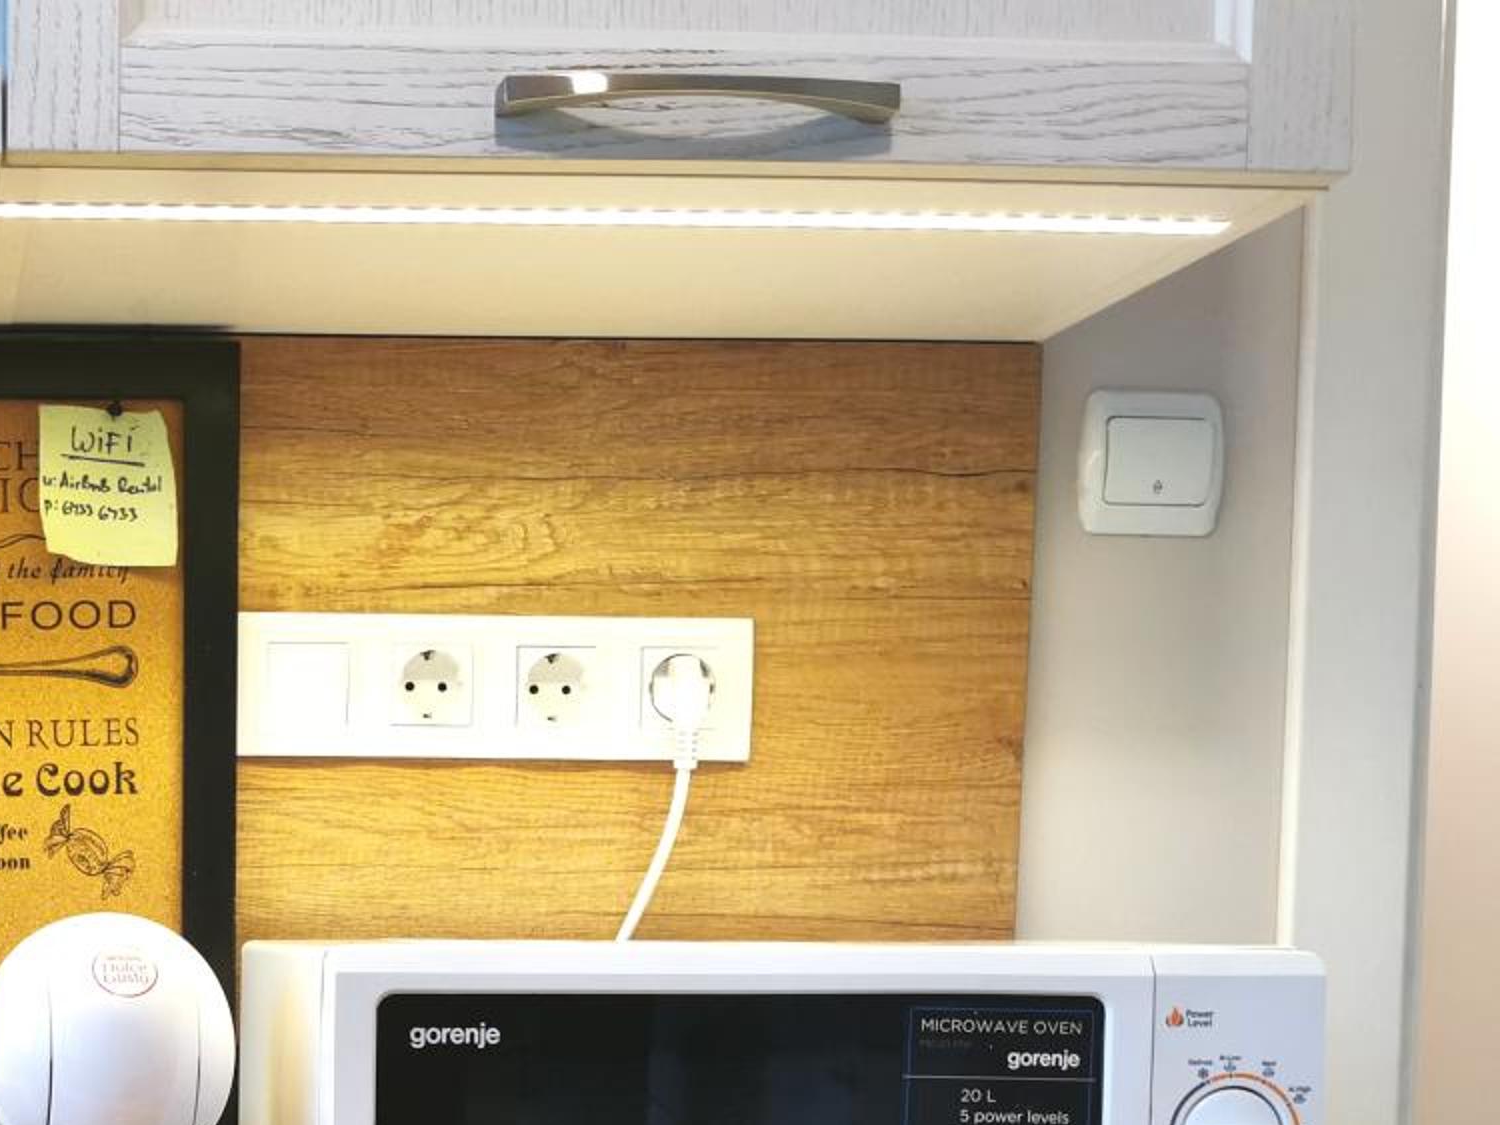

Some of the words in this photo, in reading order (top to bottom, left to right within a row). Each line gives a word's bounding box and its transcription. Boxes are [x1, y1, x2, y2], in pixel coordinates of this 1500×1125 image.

[6, 556, 42, 581] the
[0, 600, 136, 631] FOOD
[26, 717, 140, 750] RULES
[35, 761, 138, 797] Cook
[409, 1021, 501, 1049] gorenje
[920, 1018, 1029, 1035] MICROWAVE
[1033, 1020, 1083, 1035] OVEN
[1007, 1049, 1081, 1071] gorenje
[960, 1088, 982, 1103] 20
[987, 1089, 997, 1103] L
[959, 1109, 970, 1123] 5
[973, 1113, 1024, 1125] power
[1027, 1110, 1070, 1125] levels
